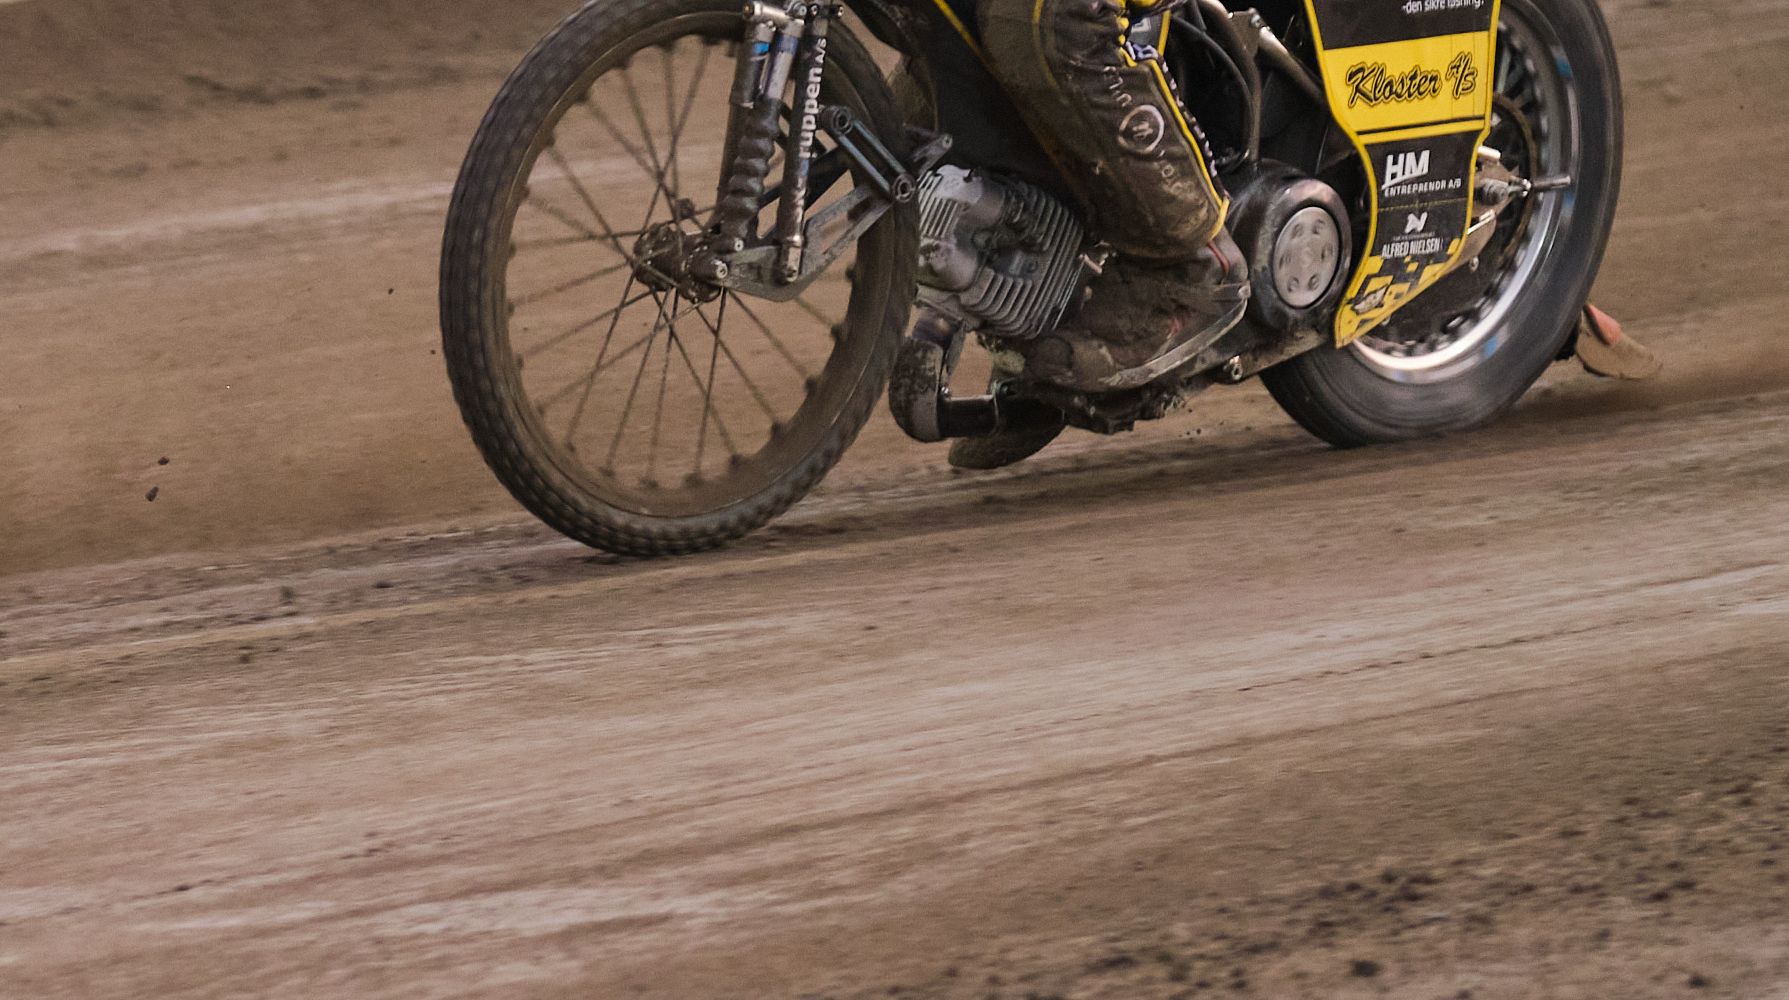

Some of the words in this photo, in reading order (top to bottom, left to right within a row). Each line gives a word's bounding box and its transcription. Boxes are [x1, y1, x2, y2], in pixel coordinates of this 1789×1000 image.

[1346, 61, 1443, 108] Kloster
[1445, 51, 1478, 99] A/S
[1383, 150, 1431, 187] HM
[1381, 241, 1410, 259] ALFRED
